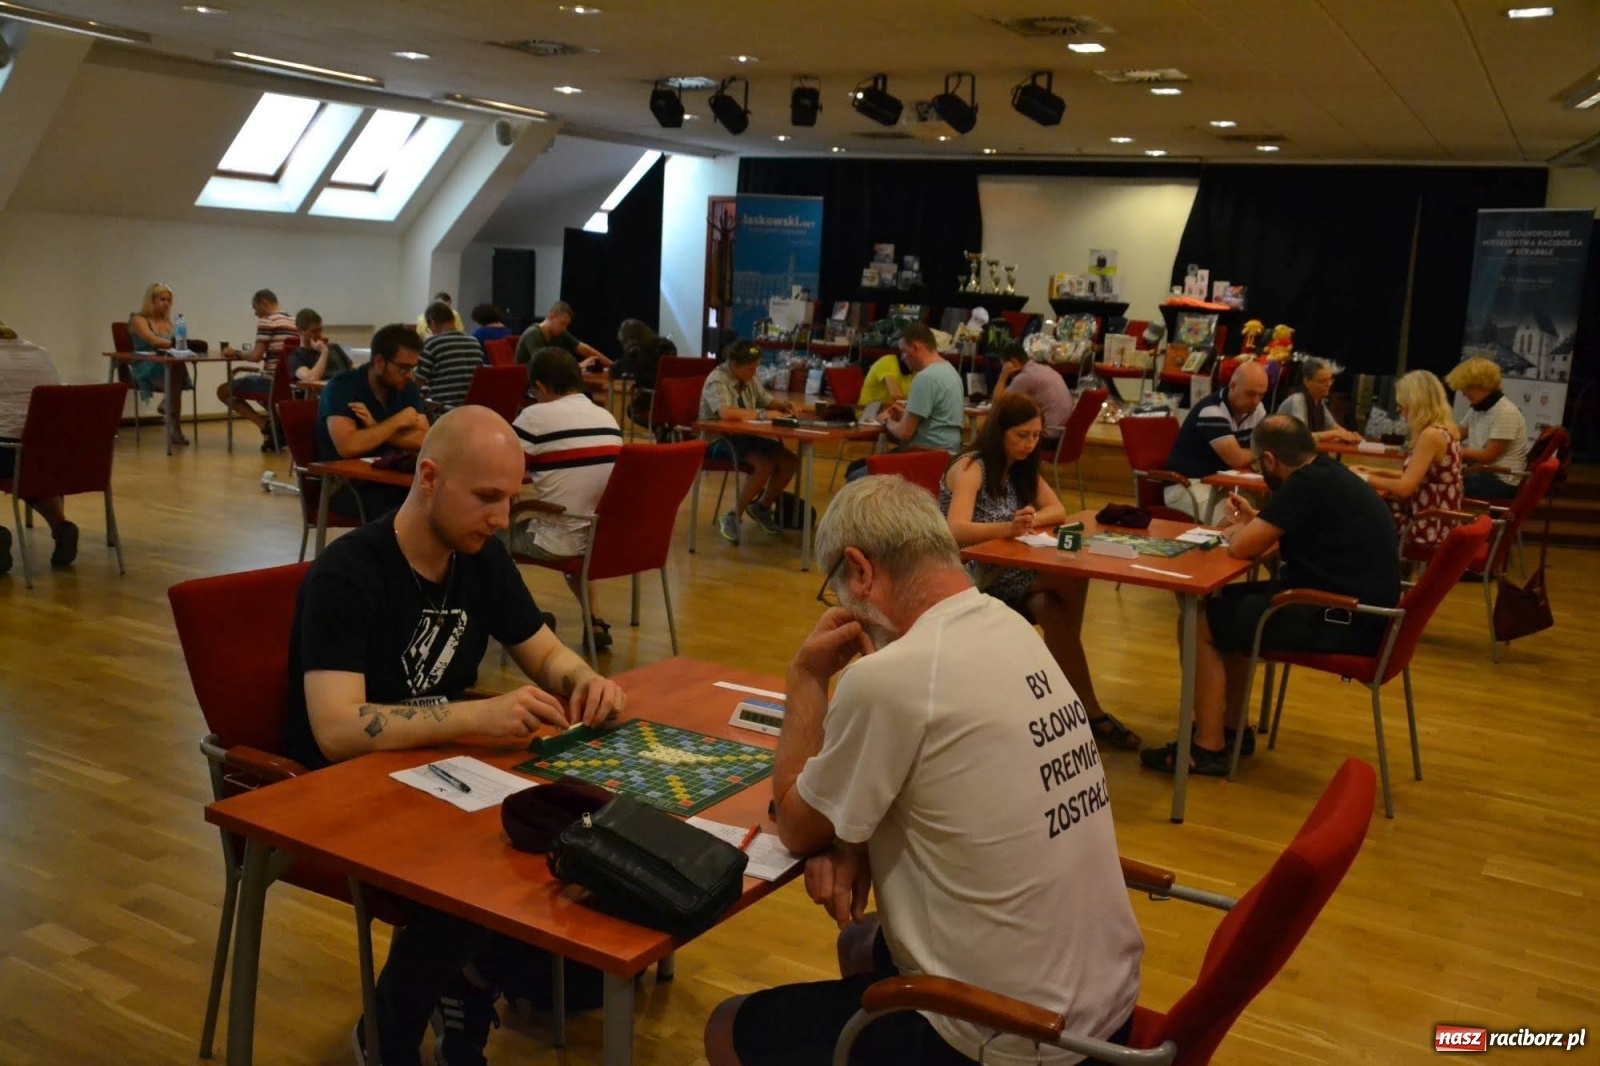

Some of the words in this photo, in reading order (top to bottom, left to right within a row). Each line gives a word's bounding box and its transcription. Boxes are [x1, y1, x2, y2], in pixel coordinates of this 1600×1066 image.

[1063, 534, 1074, 549] 5
[1025, 670, 1052, 700] BY
[1029, 700, 1087, 747] SŁOWO
